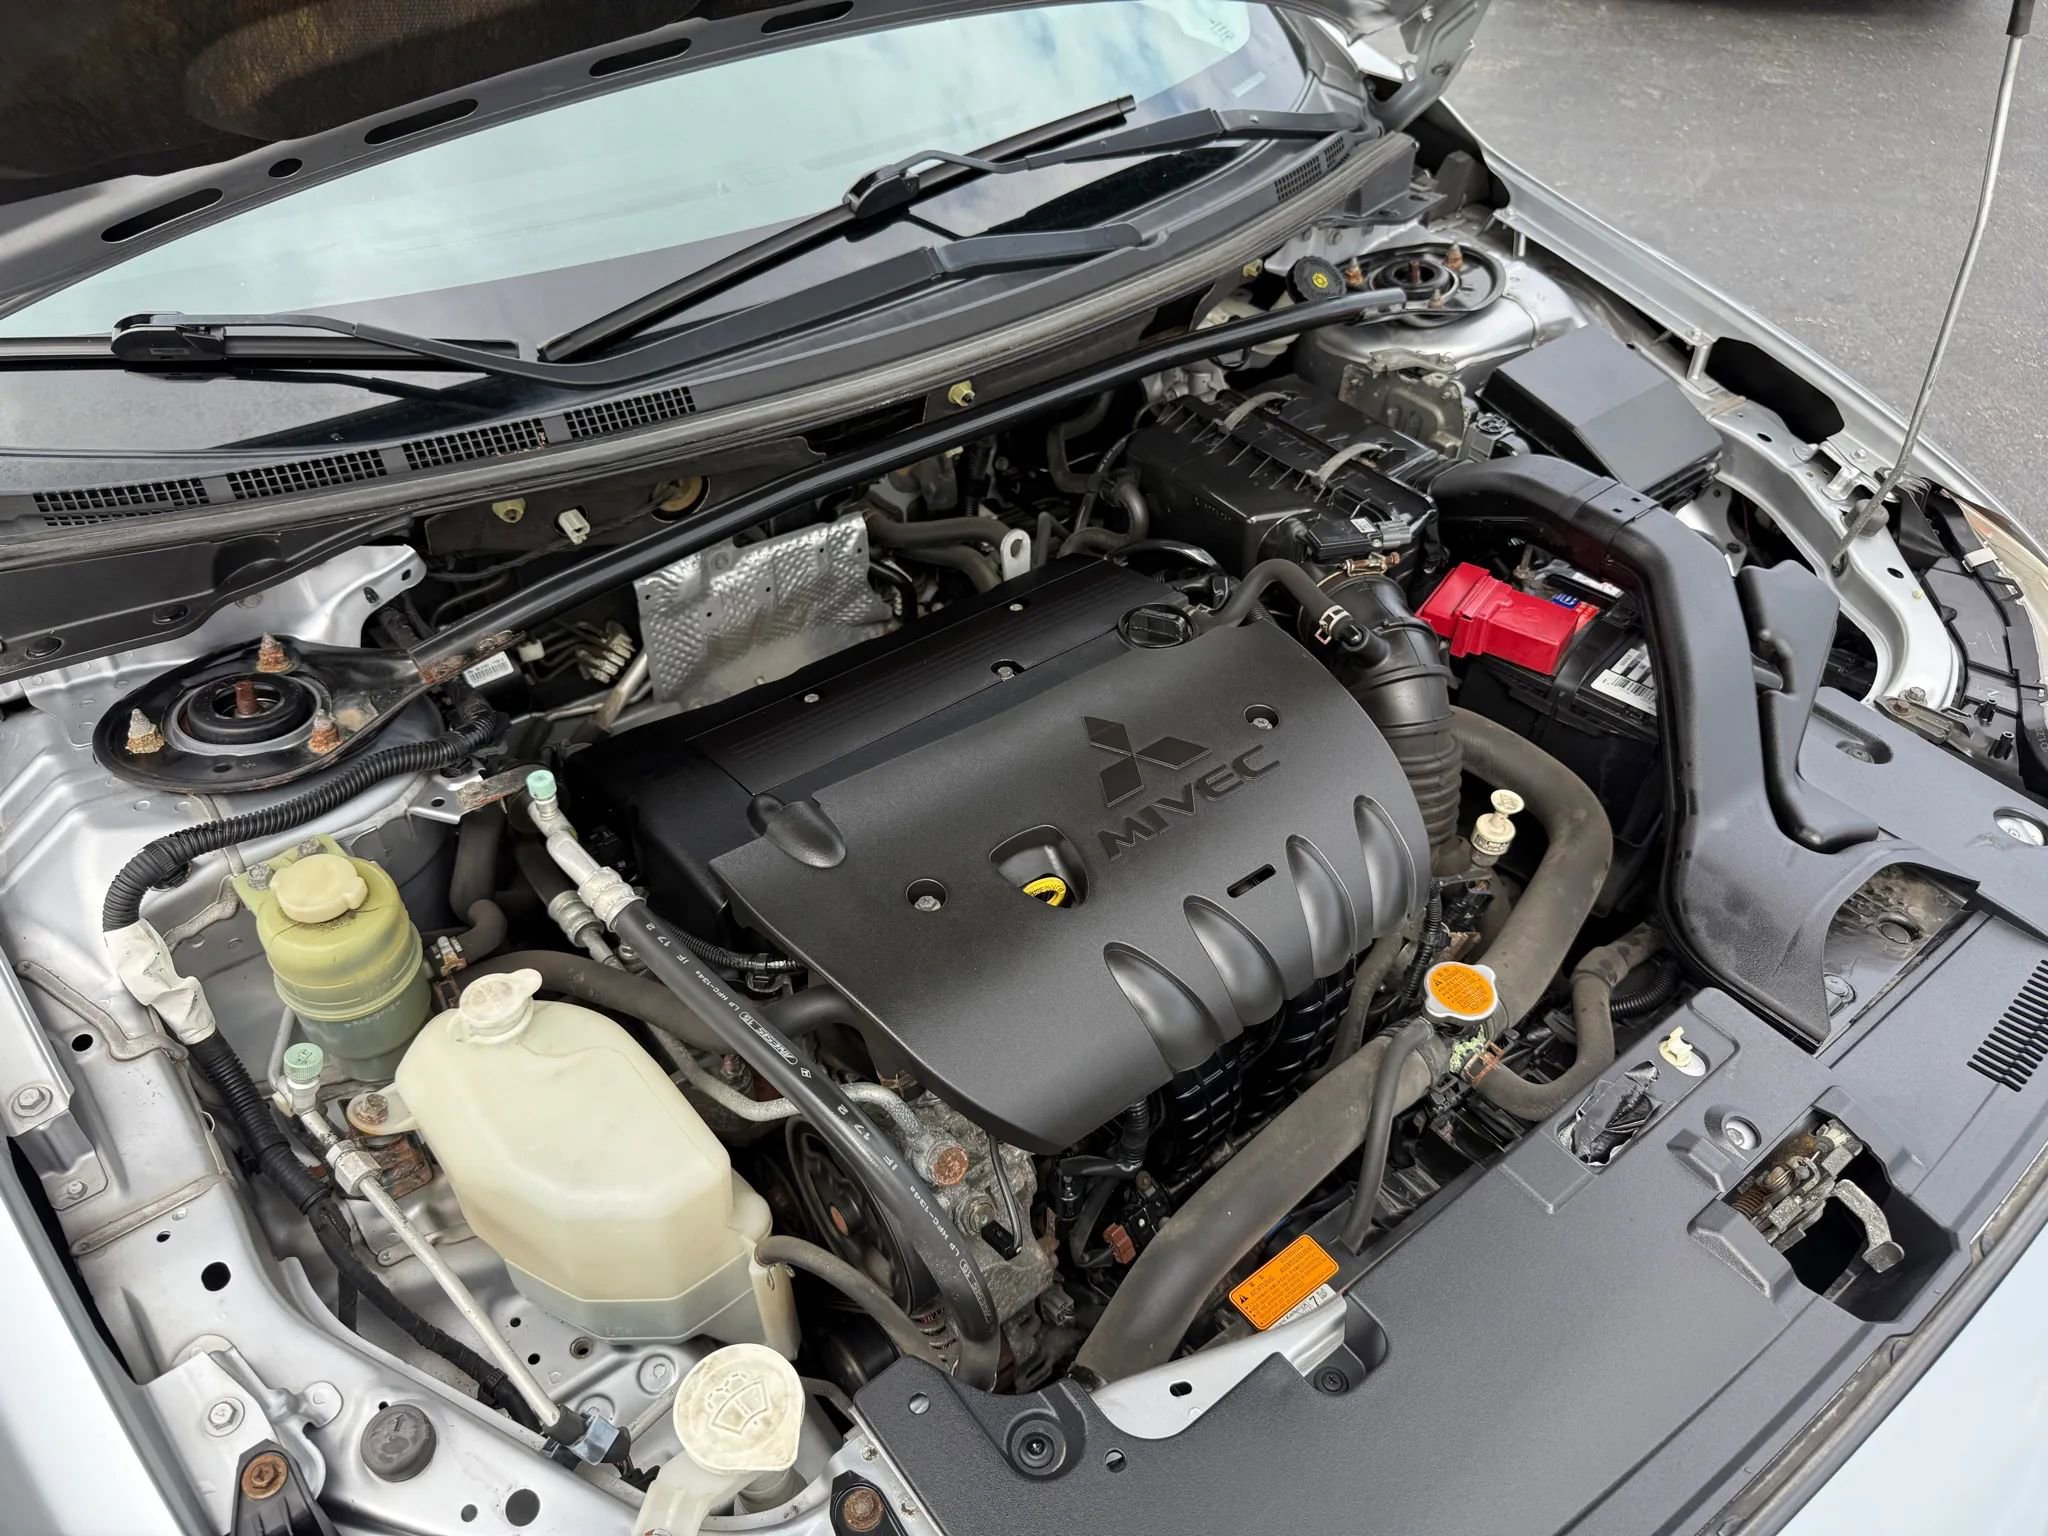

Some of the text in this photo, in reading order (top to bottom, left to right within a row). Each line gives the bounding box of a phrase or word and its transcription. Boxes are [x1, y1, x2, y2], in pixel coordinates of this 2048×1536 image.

[1098, 744, 1281, 861] MIVEC
[645, 922, 656, 931] 2
[657, 936, 671, 947] 17
[728, 1001, 740, 1011] LP
[837, 1103, 849, 1116] 2
[854, 1124, 871, 1141] 17
[949, 1242, 960, 1257] LP
[1250, 1275, 1276, 1297] ACHTUNG
